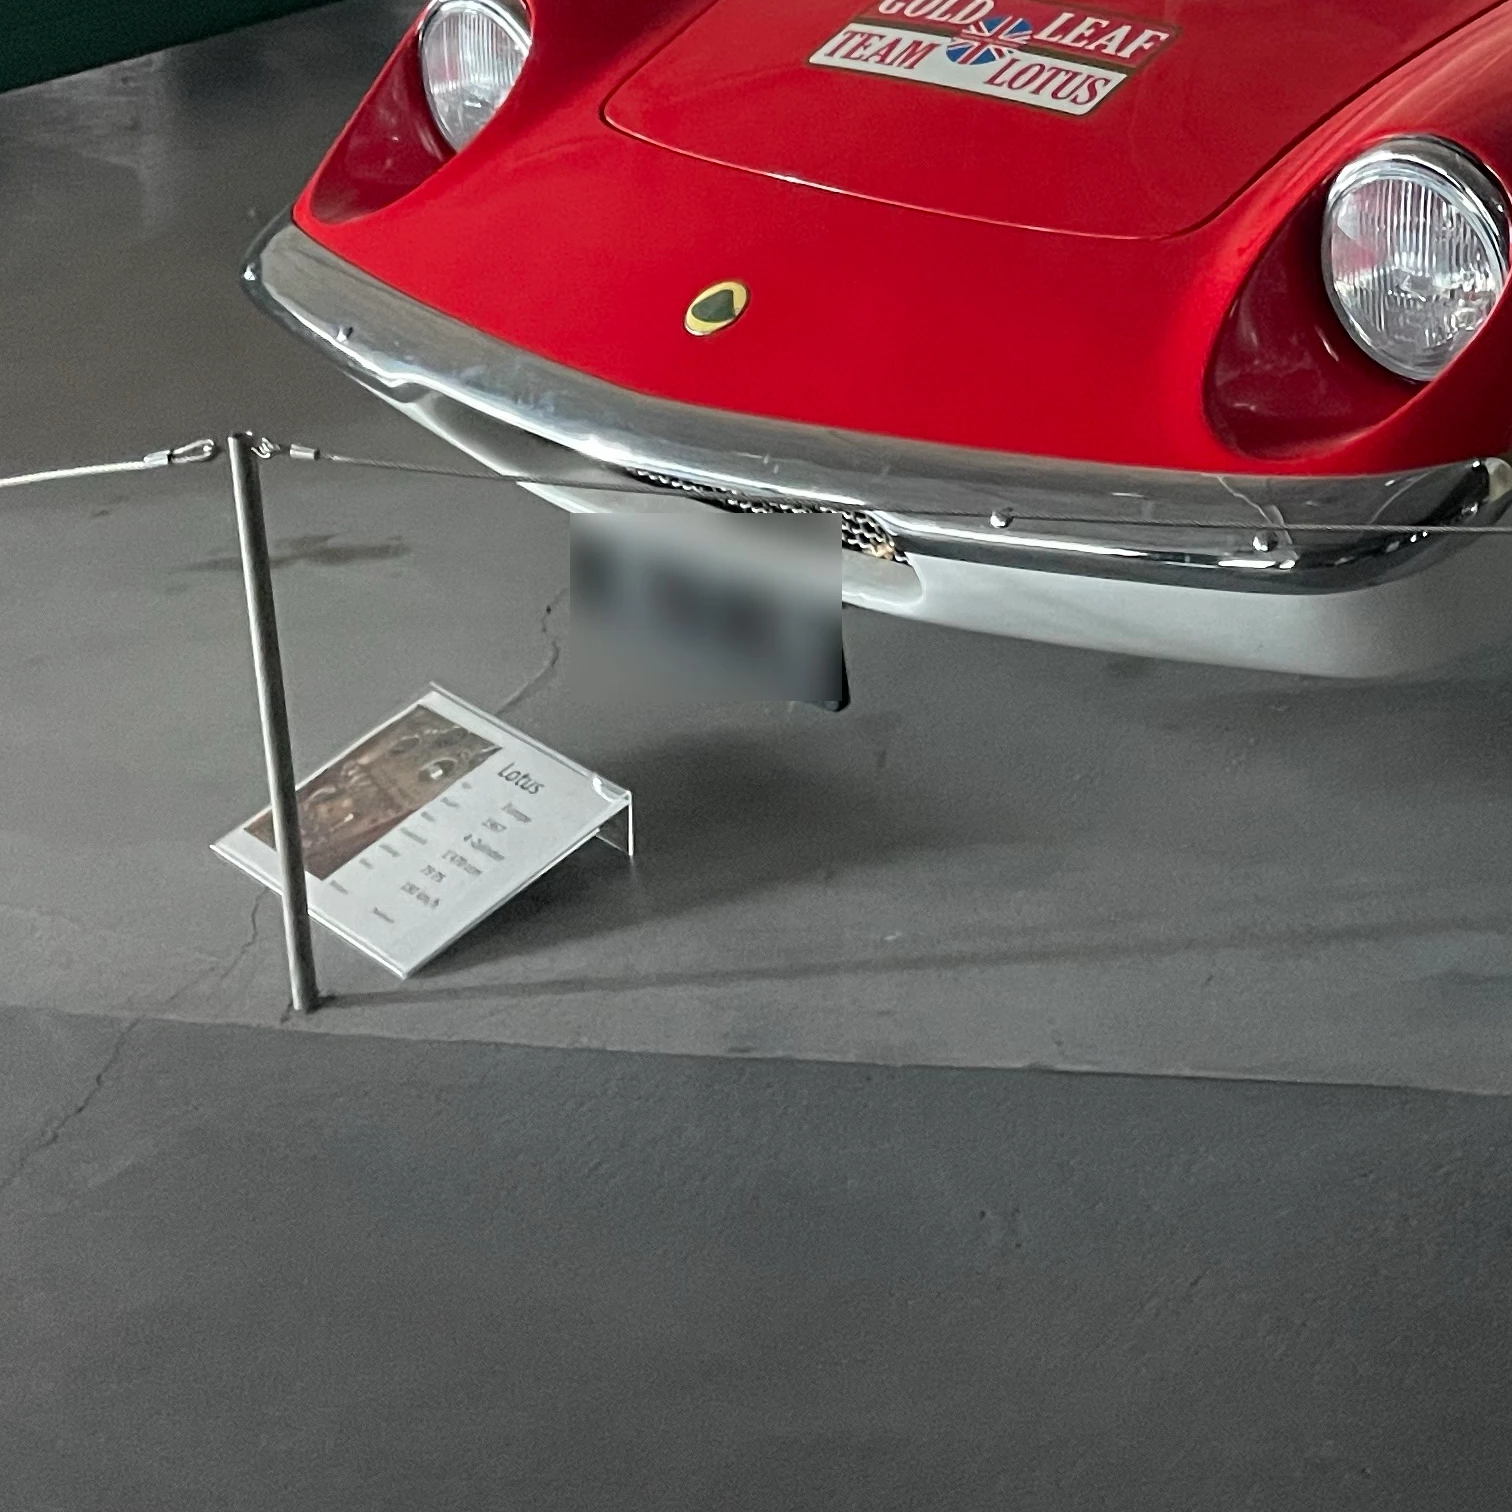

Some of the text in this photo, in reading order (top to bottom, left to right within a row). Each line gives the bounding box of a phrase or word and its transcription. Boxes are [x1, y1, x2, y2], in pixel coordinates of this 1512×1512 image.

[1032, 12, 1170, 59] LEAF
[823, 29, 1111, 106] TEAM LOTUS
[497, 761, 545, 795] Lotus
